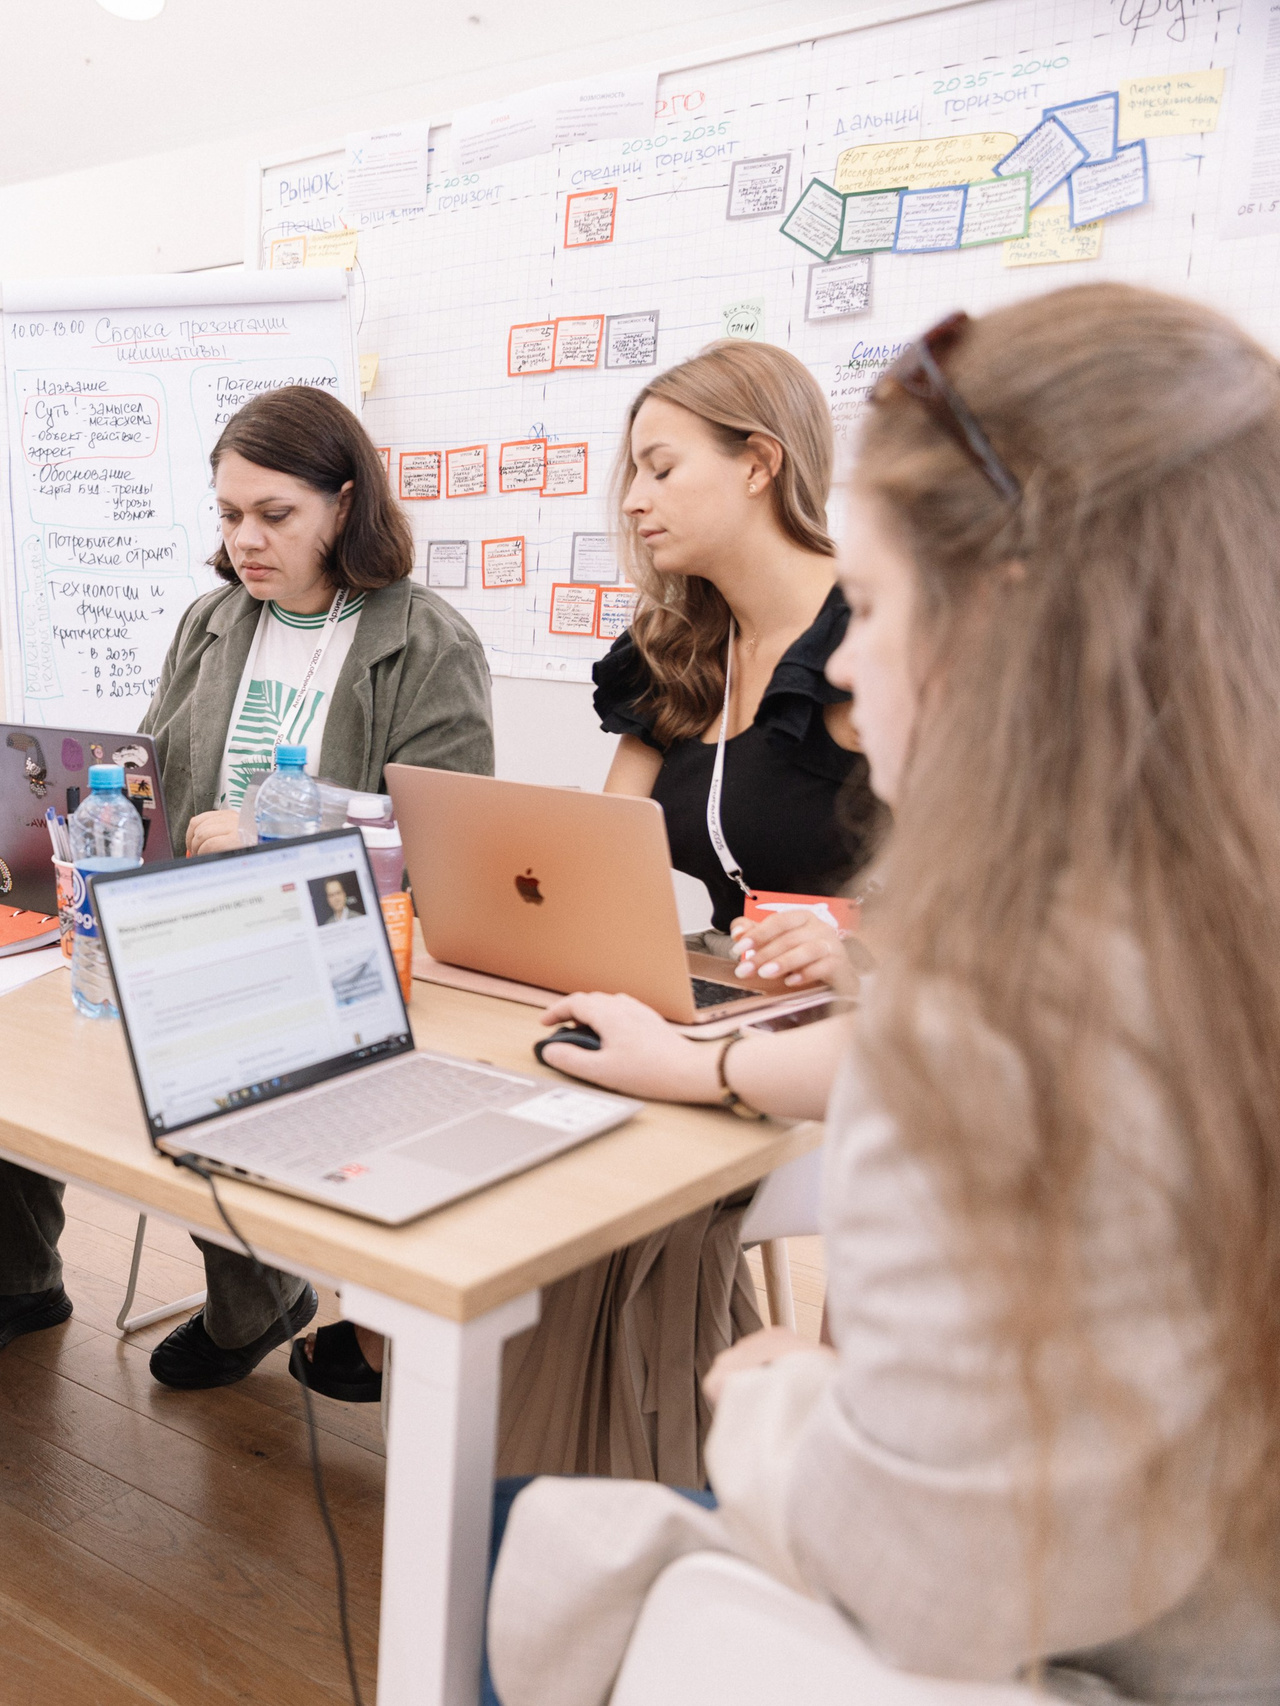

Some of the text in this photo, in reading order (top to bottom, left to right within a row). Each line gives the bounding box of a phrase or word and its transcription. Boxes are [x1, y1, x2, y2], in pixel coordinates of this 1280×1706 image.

[622, 121, 731, 155] 2030-2035
[11, 317, 288, 347] 10.00-13.00 Сборка презентации
[117, 344, 227, 362] инициативы
[36, 378, 110, 396] Название
[28, 446, 75, 462] эффект
[39, 462, 135, 482] Обоснование
[105, 647, 139, 661] 2035
[109, 664, 142, 678] 2030
